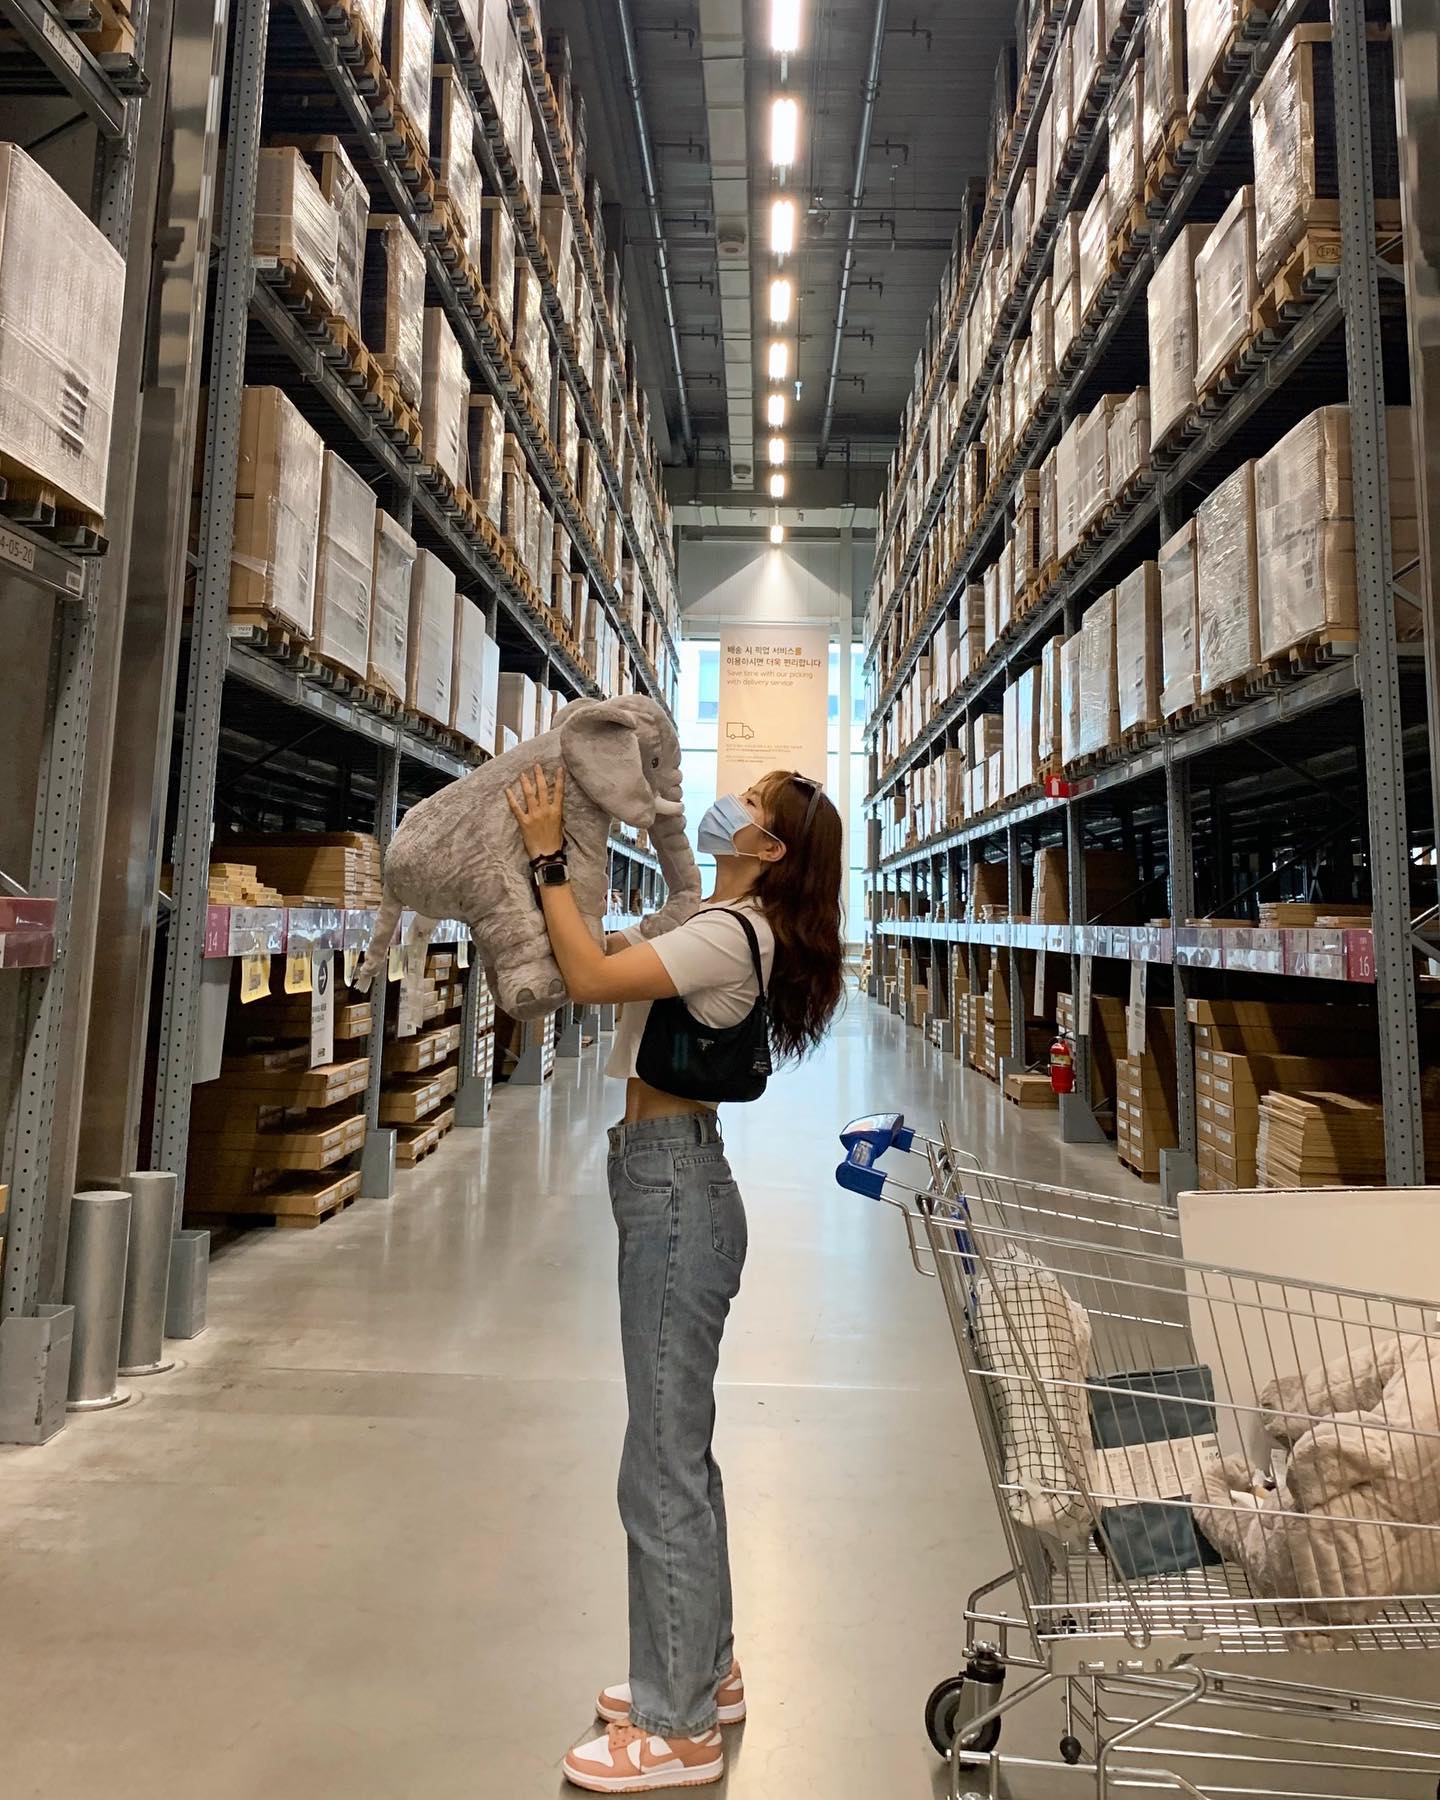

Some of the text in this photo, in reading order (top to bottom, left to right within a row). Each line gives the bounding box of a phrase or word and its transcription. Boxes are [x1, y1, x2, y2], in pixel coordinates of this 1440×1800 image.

[727, 646, 742, 655] 배송
[745, 646, 752, 655] 시
[772, 646, 802, 656] 서비스를
[726, 657, 821, 668] 이용하시면 더욱 편리합니다
[743, 679, 769, 687] delivery
[208, 931, 218, 951] 14
[1359, 955, 1370, 977] 16
